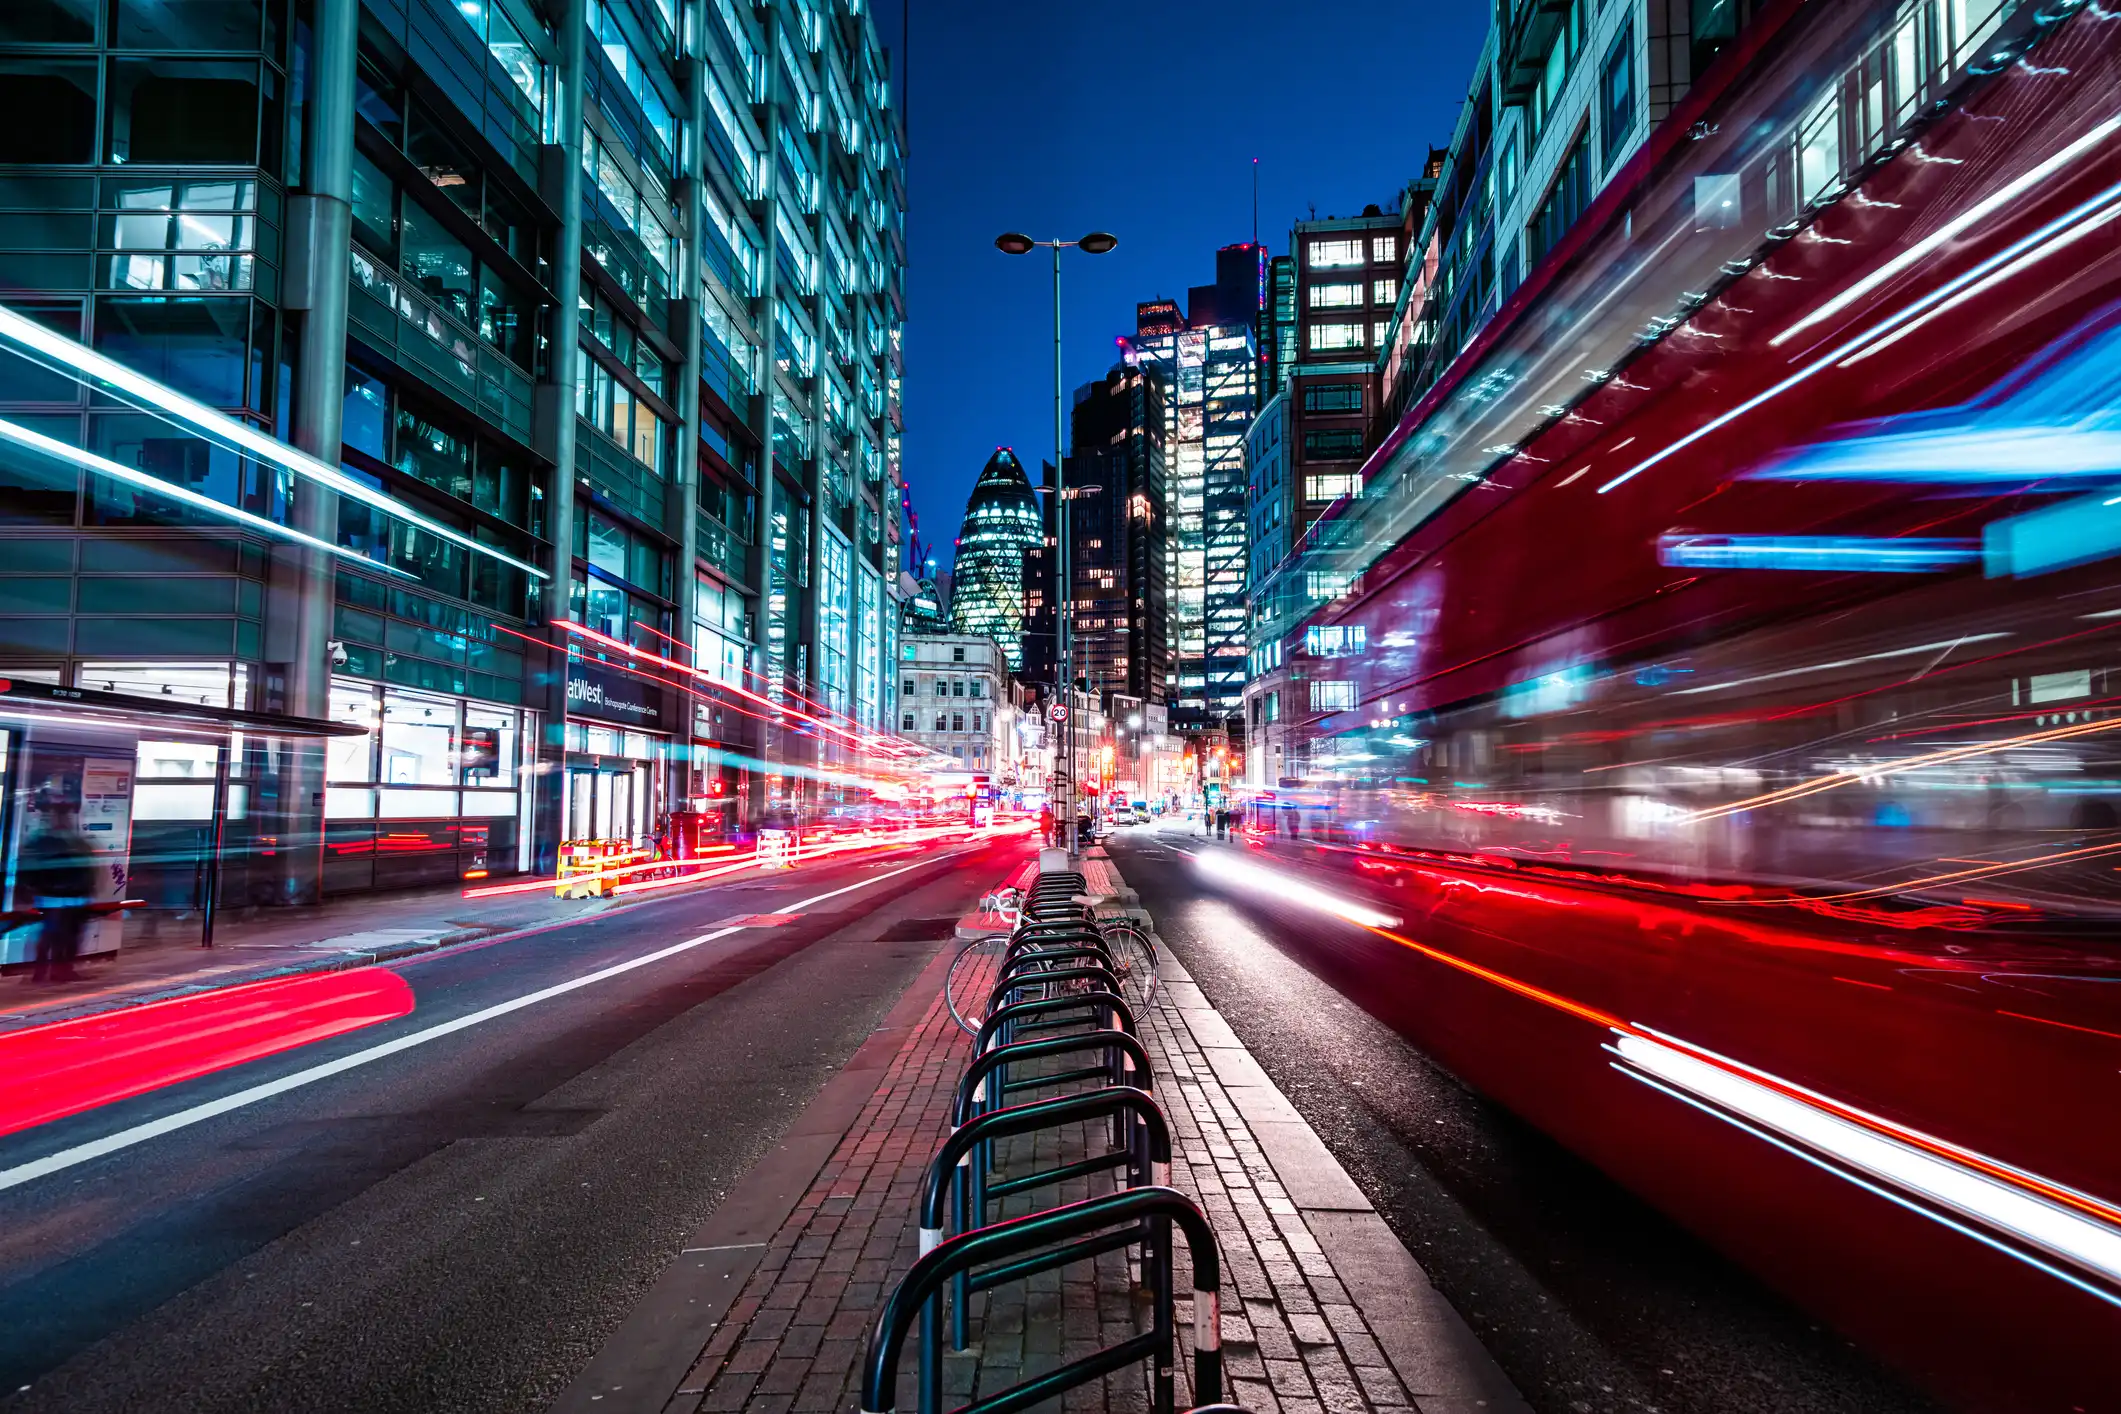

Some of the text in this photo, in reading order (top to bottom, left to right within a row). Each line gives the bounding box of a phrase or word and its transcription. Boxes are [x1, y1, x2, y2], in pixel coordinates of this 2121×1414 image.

[567, 678, 602, 704] atWest
[604, 697, 627, 711] Bishopsgate
[627, 702, 647, 714] Conference
[1053, 708, 1066, 717] 20
